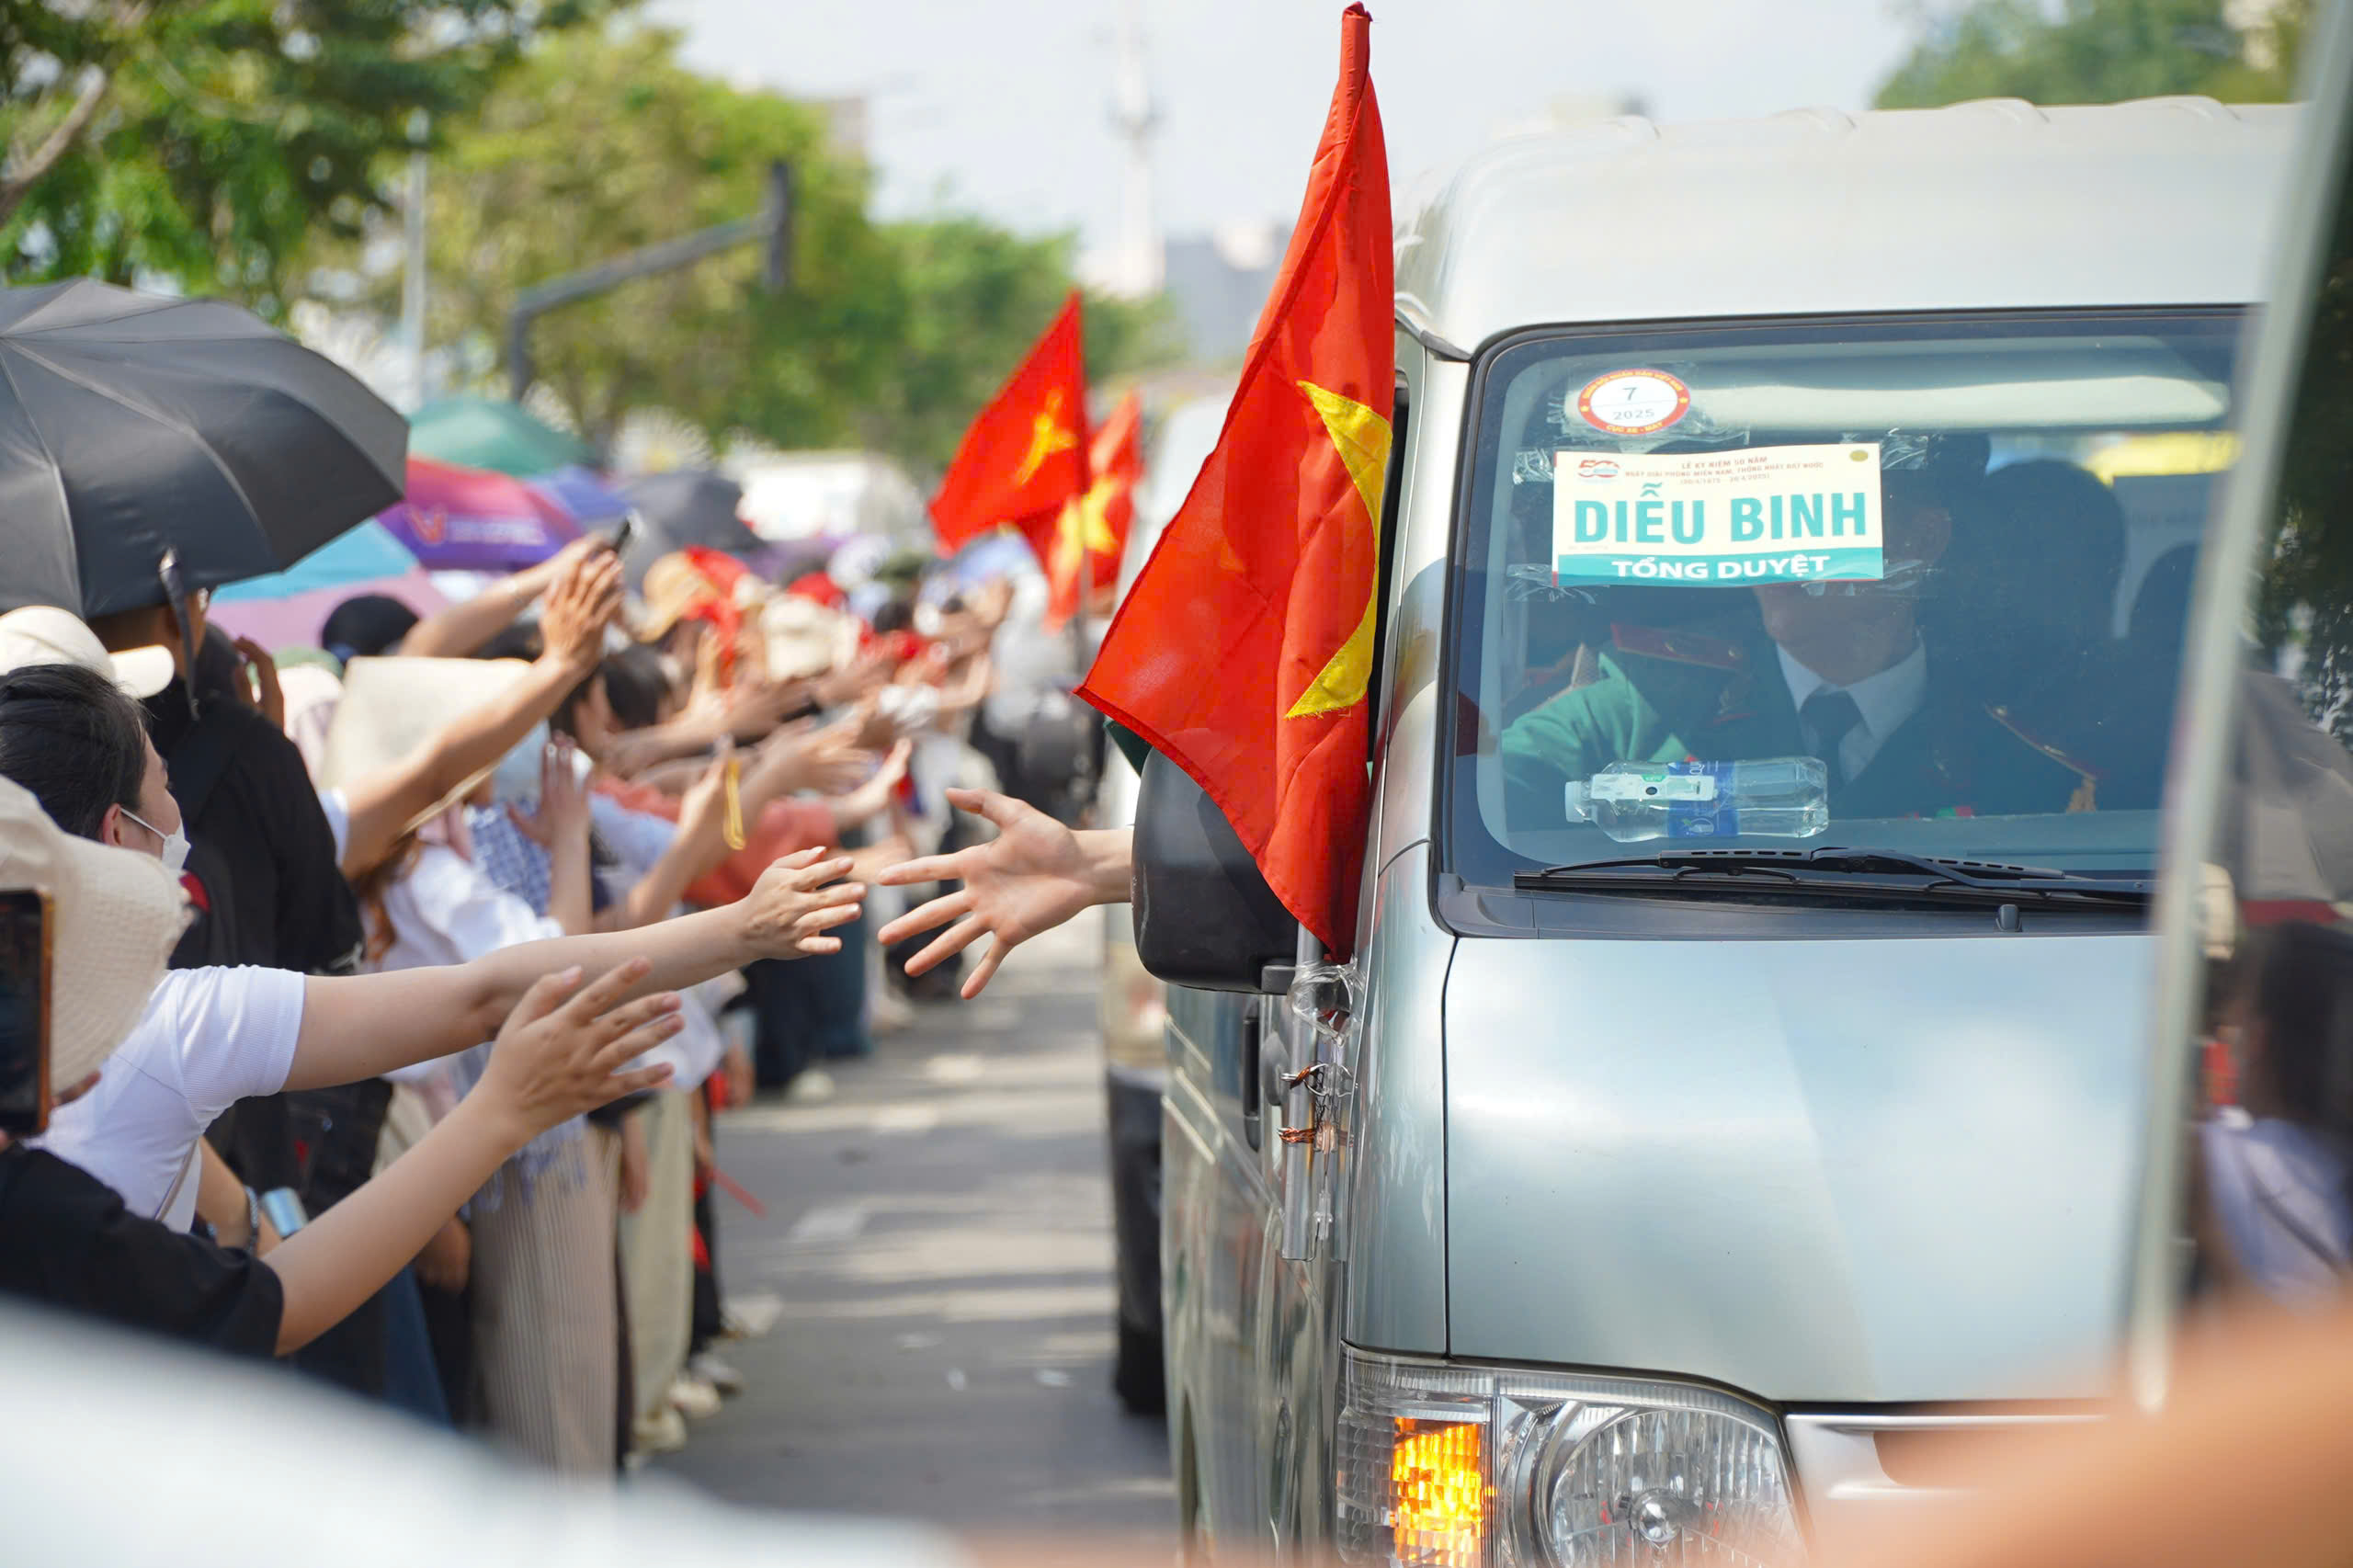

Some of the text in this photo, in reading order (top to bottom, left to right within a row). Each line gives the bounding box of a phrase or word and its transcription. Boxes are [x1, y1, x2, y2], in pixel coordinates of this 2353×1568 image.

[1622, 387, 1638, 401] 7
[1613, 408, 1654, 420] 2025
[1574, 482, 1866, 544] DIỄU BINH
[1611, 555, 1831, 579] TỔNG DUYỆT
